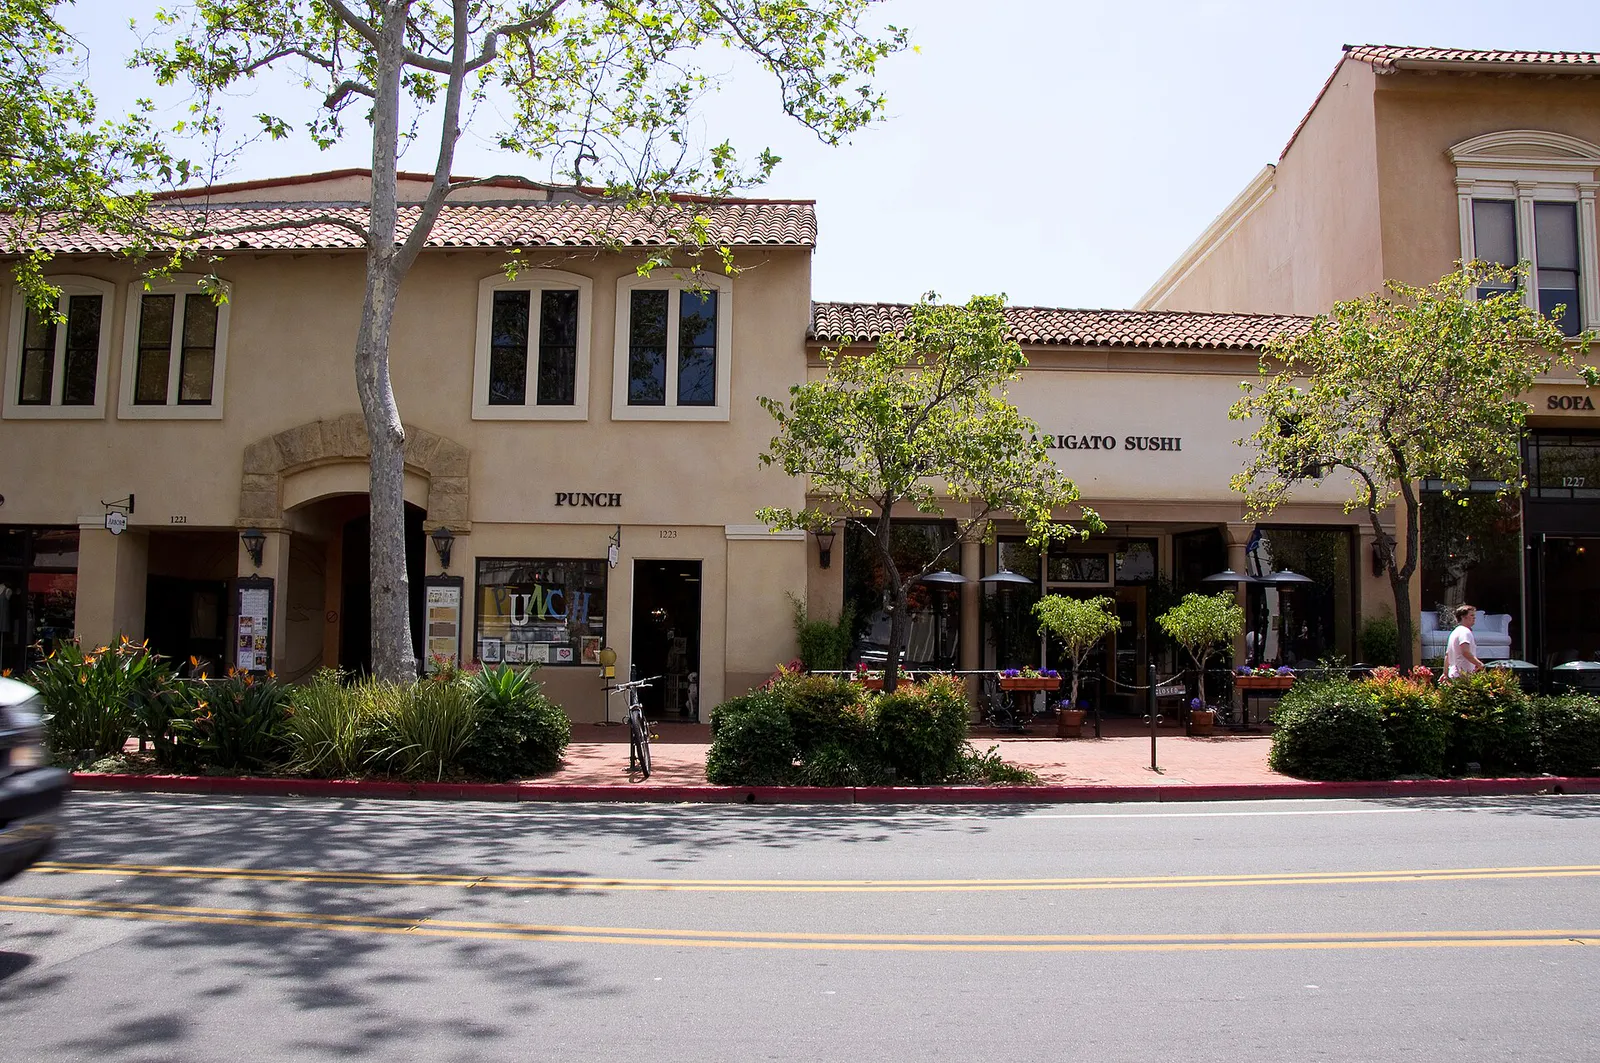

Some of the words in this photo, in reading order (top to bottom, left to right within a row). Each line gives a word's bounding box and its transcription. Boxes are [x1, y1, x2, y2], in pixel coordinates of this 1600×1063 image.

[1547, 395, 1595, 411] SOFA
[1124, 436, 1182, 452] SUSHI
[1562, 476, 1585, 487] 1227
[554, 492, 622, 507] PUNCH
[170, 515, 187, 524] 1221
[659, 530, 678, 539] 1223
[491, 583, 592, 626] PUNCH
